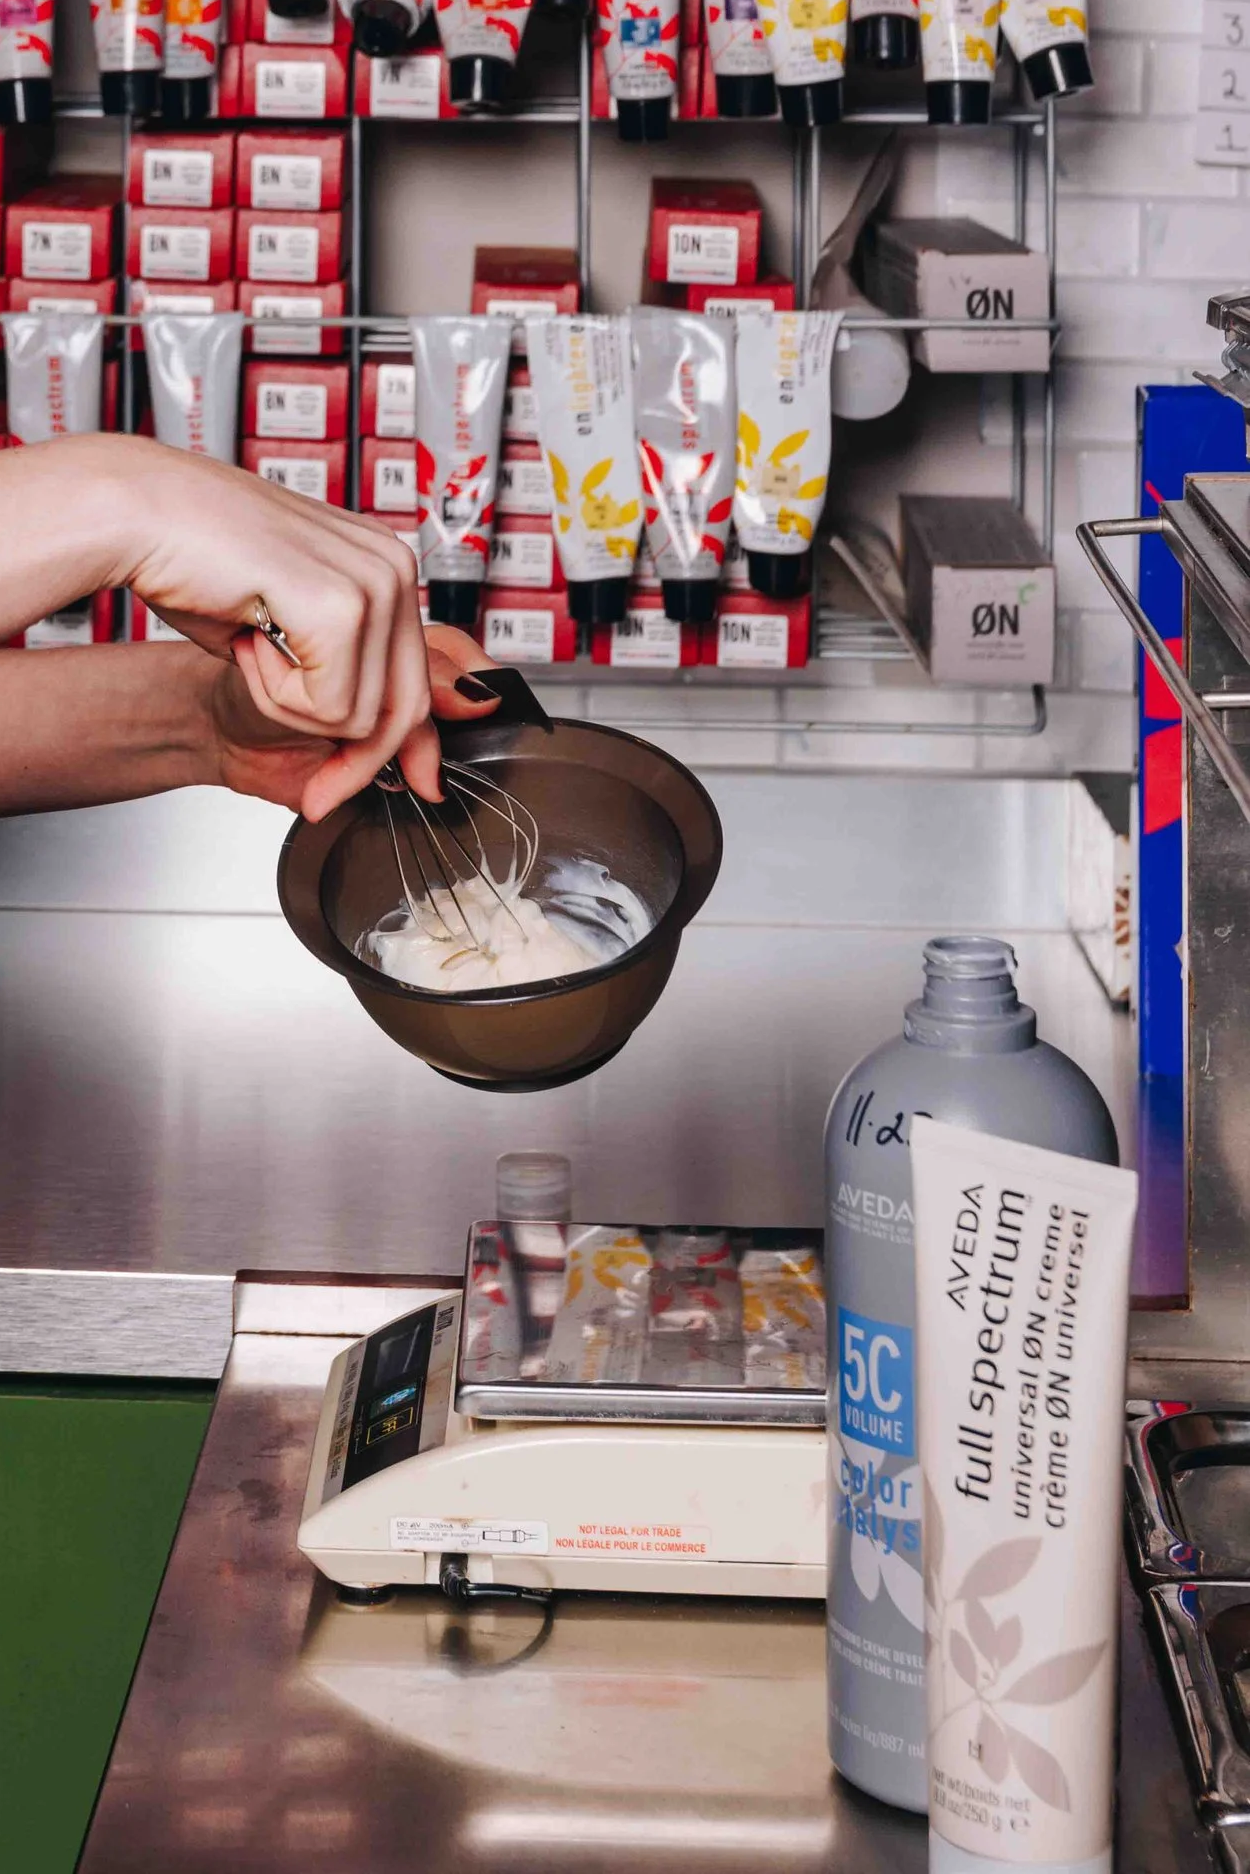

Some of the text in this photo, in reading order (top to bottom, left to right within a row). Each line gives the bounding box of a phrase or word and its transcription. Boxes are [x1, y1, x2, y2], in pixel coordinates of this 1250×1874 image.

[1223, 12, 1245, 46] 3
[1222, 69, 1247, 101] 2
[1216, 124, 1248, 152] 1
[673, 233, 701, 254] 10N
[966, 287, 1014, 320] ØN
[47, 356, 67, 432] pectrum
[491, 618, 513, 637] 9N
[722, 620, 751, 641] 10N
[972, 601, 1020, 637] ØN
[838, 1182, 914, 1225] AVEDA
[947, 1183, 985, 1310] AVEDA
[955, 1190, 1026, 1502] full spectrum
[1012, 1204, 1065, 1519] universal ØN creme
[844, 1323, 901, 1414] 5C
[1040, 1209, 1090, 1528] crème ØN universel
[845, 1403, 903, 1445] VOLUME
[841, 1458, 912, 1509] color
[555, 1538, 575, 1549] NON
[613, 1540, 639, 1551] POUR
[641, 1541, 652, 1552] LE
[654, 1541, 706, 1553] COMMERCE
[579, 1525, 682, 1538] NOT LEGAL FOR TRADE
[893, 1649, 924, 1669] DEVEL
[895, 1668, 924, 1686] TRAIT
